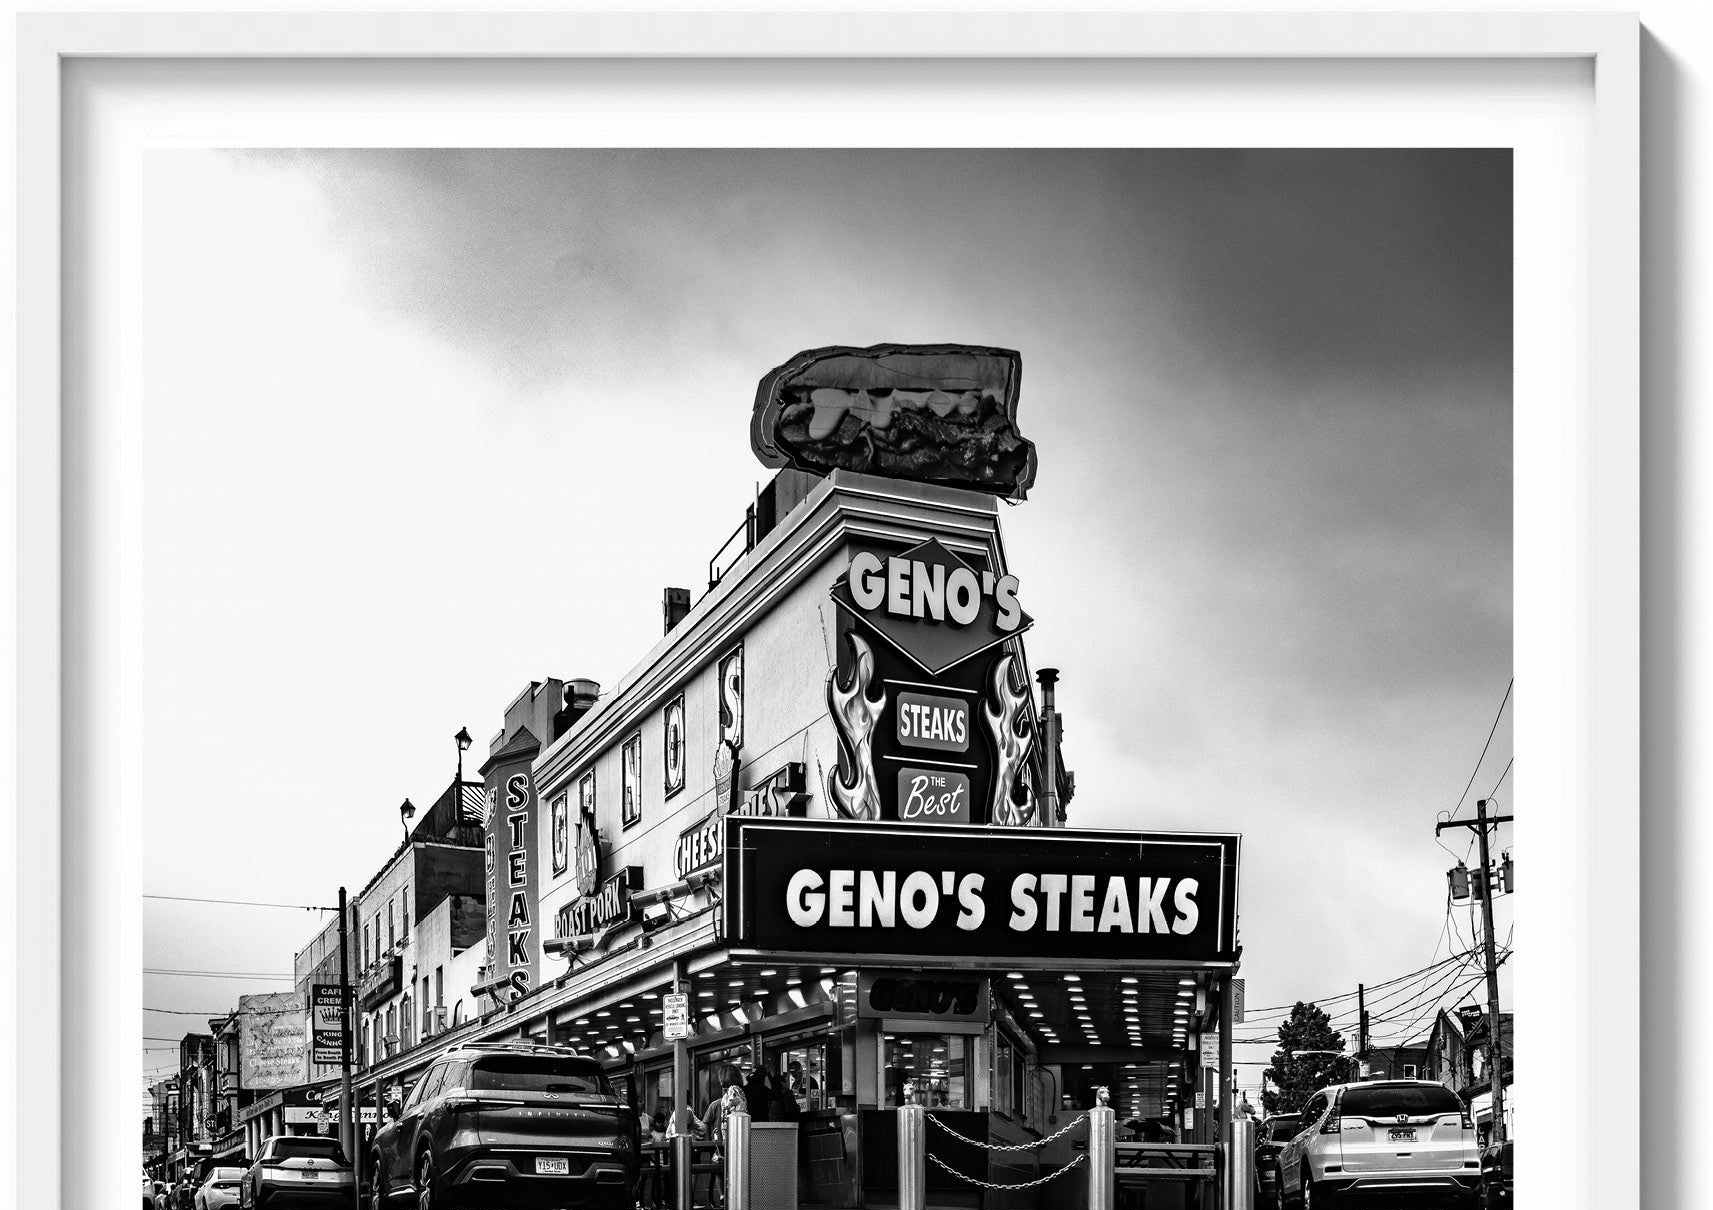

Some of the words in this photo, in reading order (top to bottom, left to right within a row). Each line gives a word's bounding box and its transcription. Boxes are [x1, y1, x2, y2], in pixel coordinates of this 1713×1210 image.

[848, 551, 1022, 632] GENO'S
[901, 703, 966, 743] STEAKS
[903, 775, 965, 819] Best
[930, 776, 946, 788] THE
[506, 773, 532, 1001] STEAKS
[555, 903, 587, 939] ROAST
[590, 876, 621, 929] PORK
[785, 868, 986, 932] GENO'S
[1009, 872, 1200, 936] STEAKS
[316, 1035, 343, 1046] CANNO
